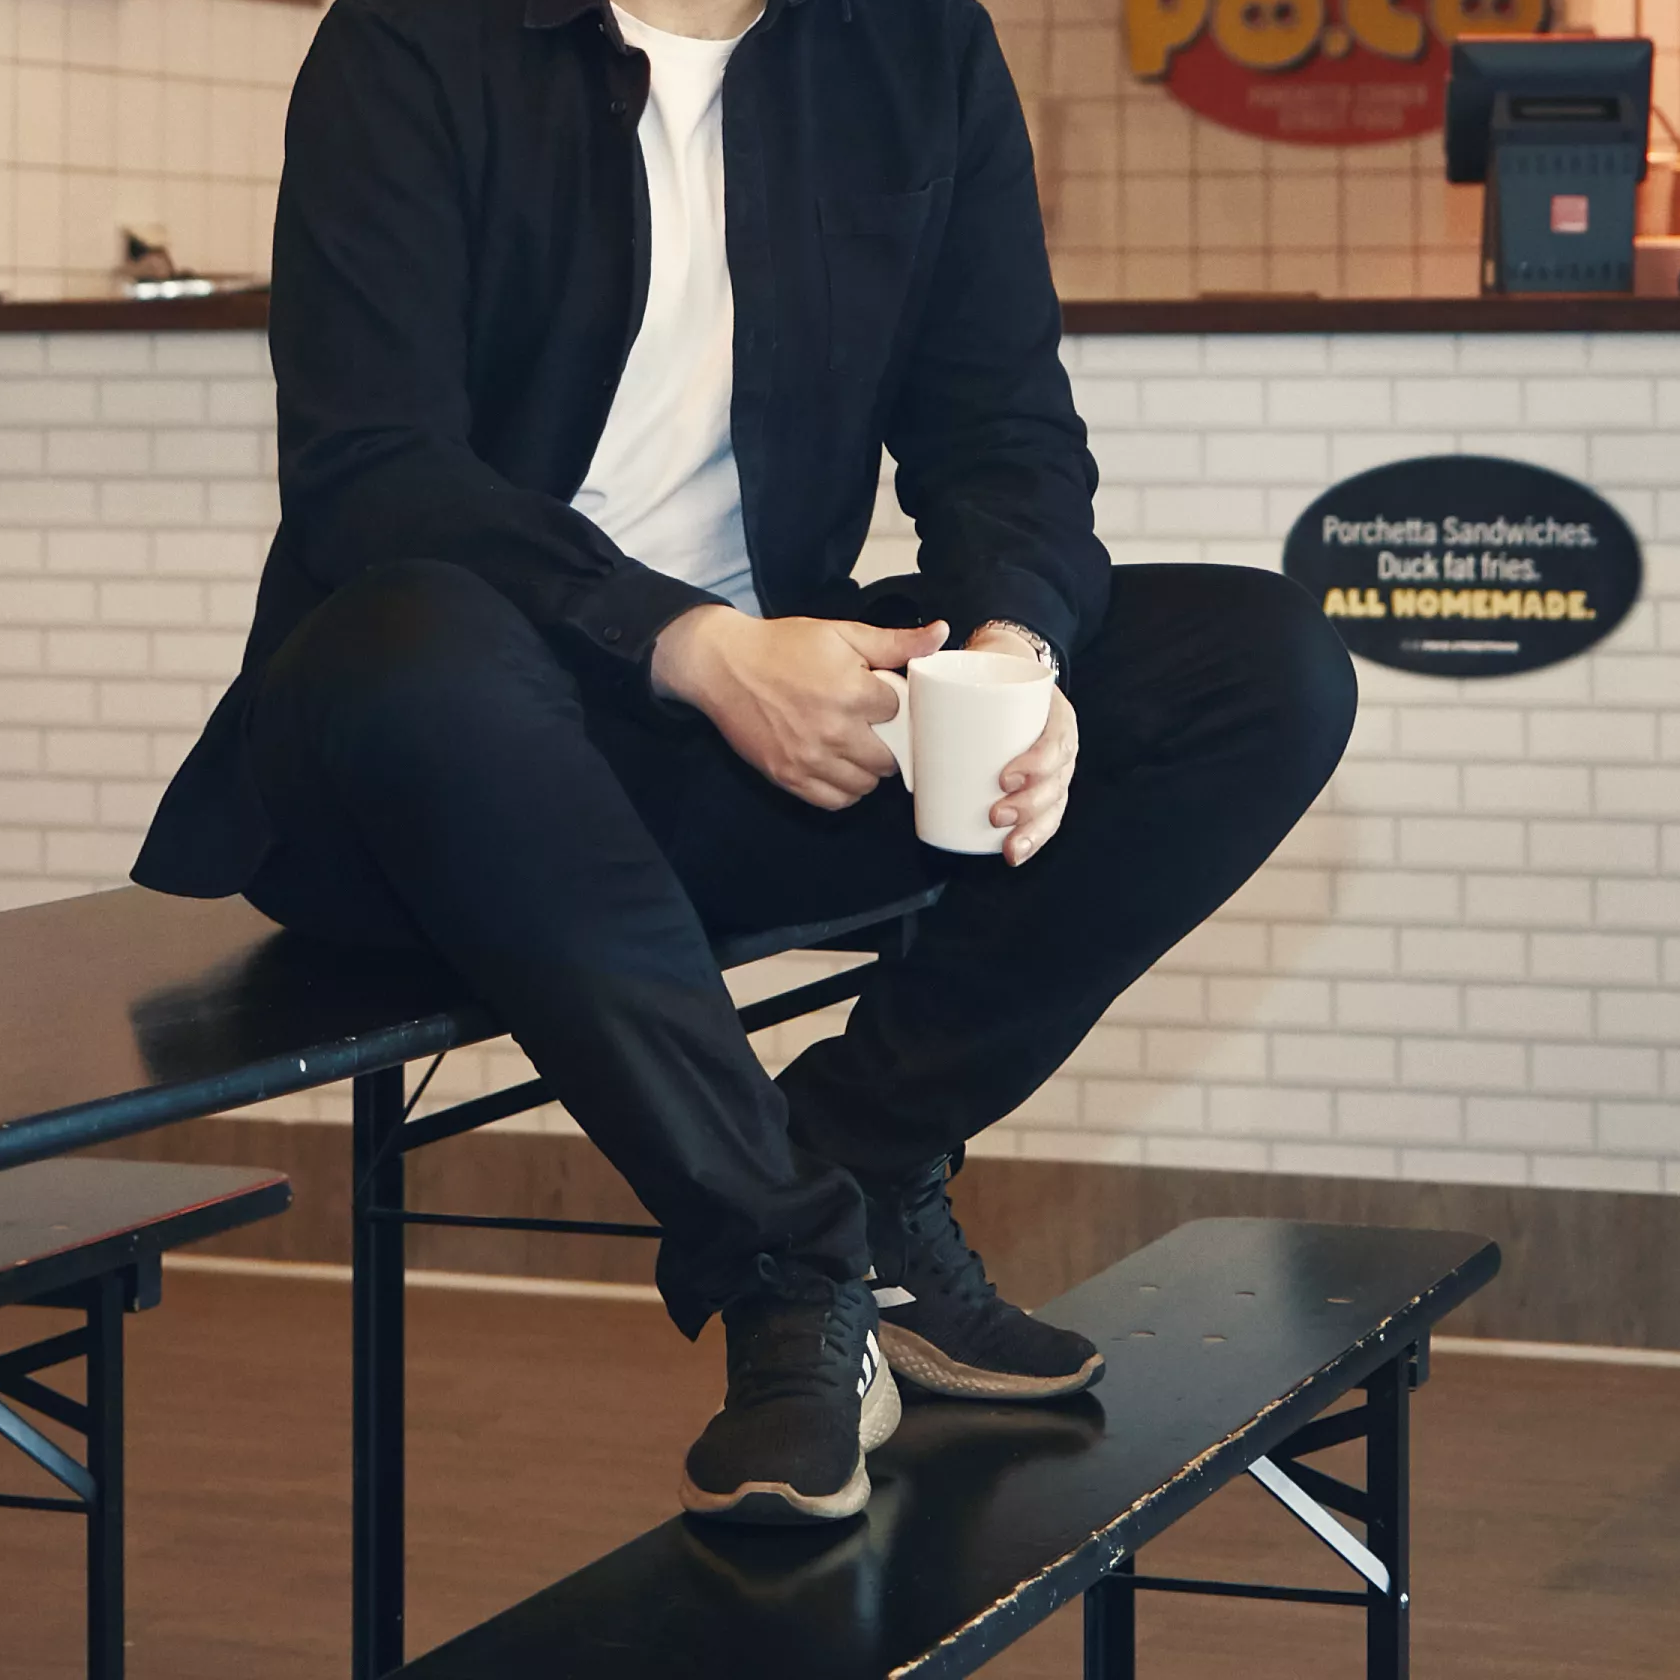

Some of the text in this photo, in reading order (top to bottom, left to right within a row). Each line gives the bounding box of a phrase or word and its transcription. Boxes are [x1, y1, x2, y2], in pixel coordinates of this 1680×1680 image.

[1322, 513, 1599, 547] Porchetta Sandwiches.
[1377, 551, 1542, 582] Duck fat fries.
[1323, 587, 1598, 621] ALL HOMEMADE.
